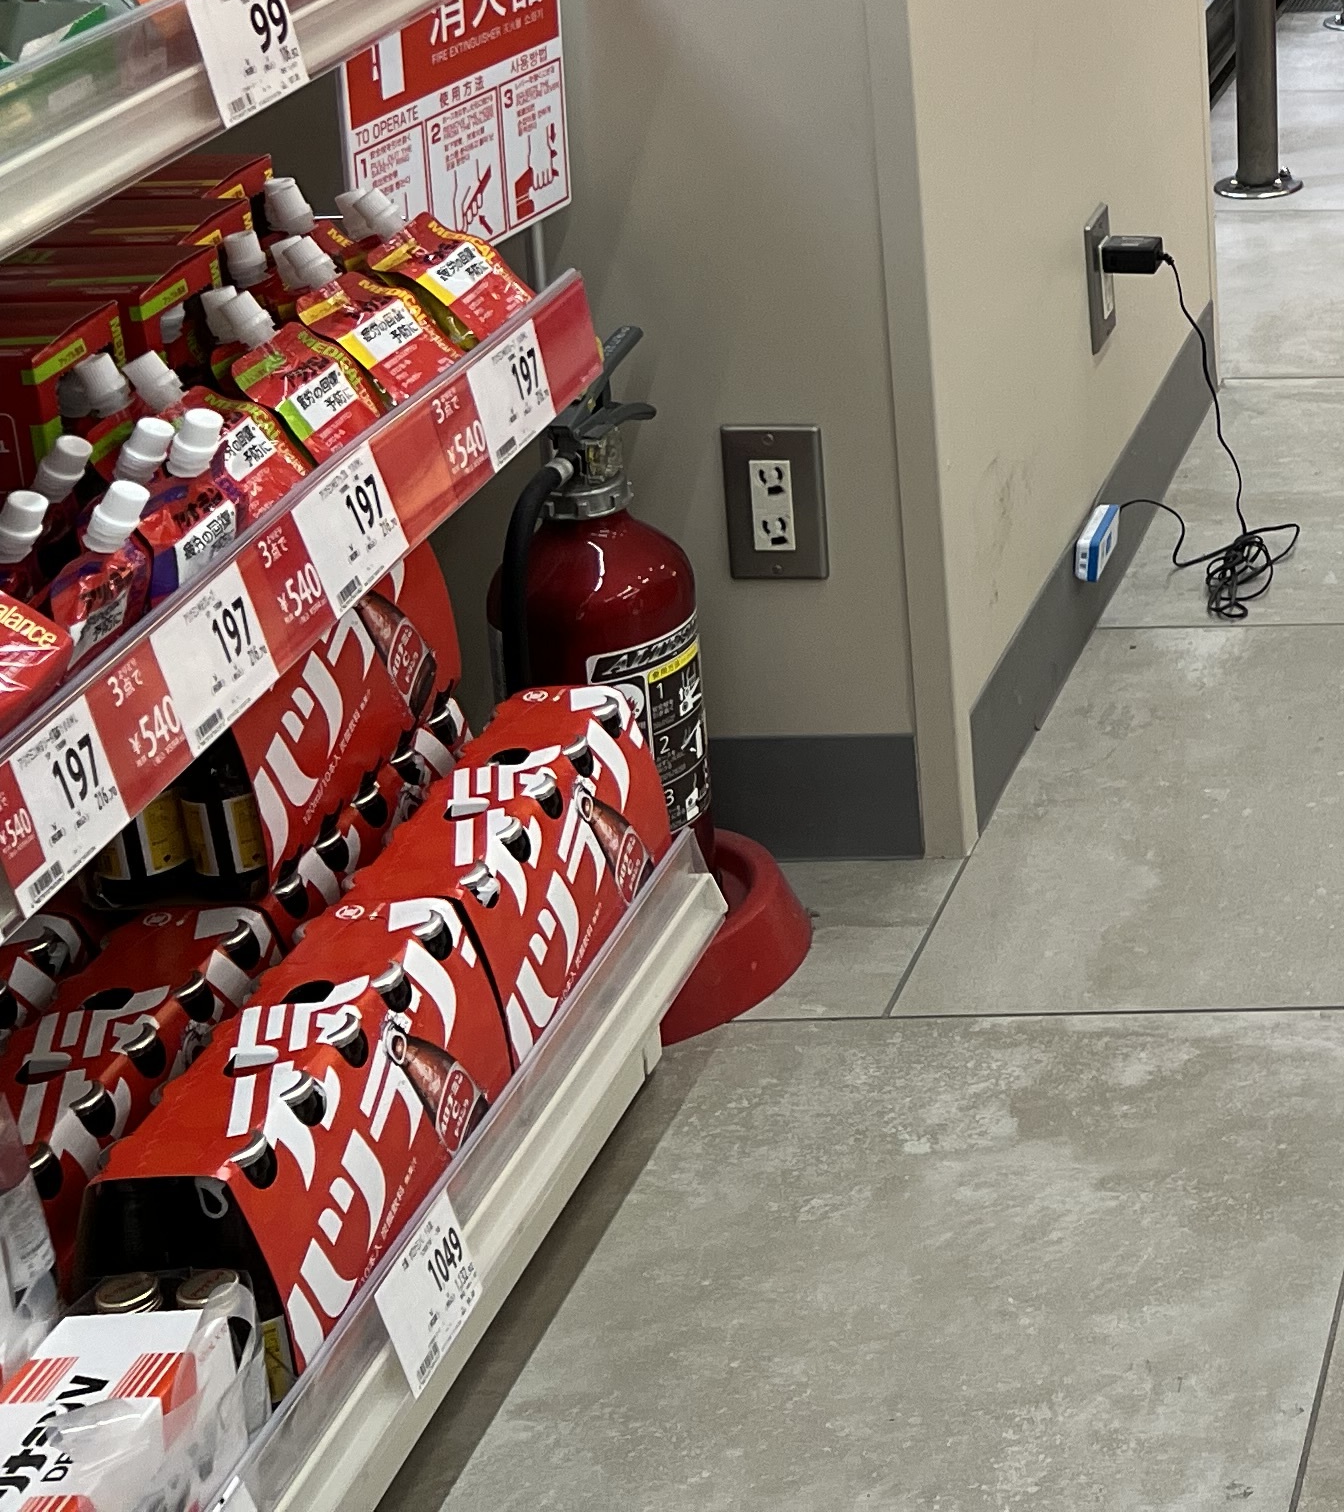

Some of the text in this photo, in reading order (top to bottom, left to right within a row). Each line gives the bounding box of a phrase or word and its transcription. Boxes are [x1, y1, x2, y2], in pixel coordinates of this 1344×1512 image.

[430, 49, 449, 66] FIRE
[438, 75, 487, 109] 使用方法
[503, 88, 514, 110] 3
[354, 105, 421, 149] TO OPERATE
[430, 122, 442, 145] 2
[359, 157, 369, 180] 1
[427, 219, 497, 267] MEDICAL
[510, 347, 540, 401] 197
[446, 419, 488, 469] ¥540
[345, 473, 384, 536] 197
[276, 561, 323, 618] ¥540
[211, 595, 252, 664] 197
[656, 682, 665, 700] 1
[127, 693, 182, 759] ¥540
[658, 735, 671, 755] 2
[52, 733, 99, 811] 197
[427, 1226, 464, 1293] 1049
